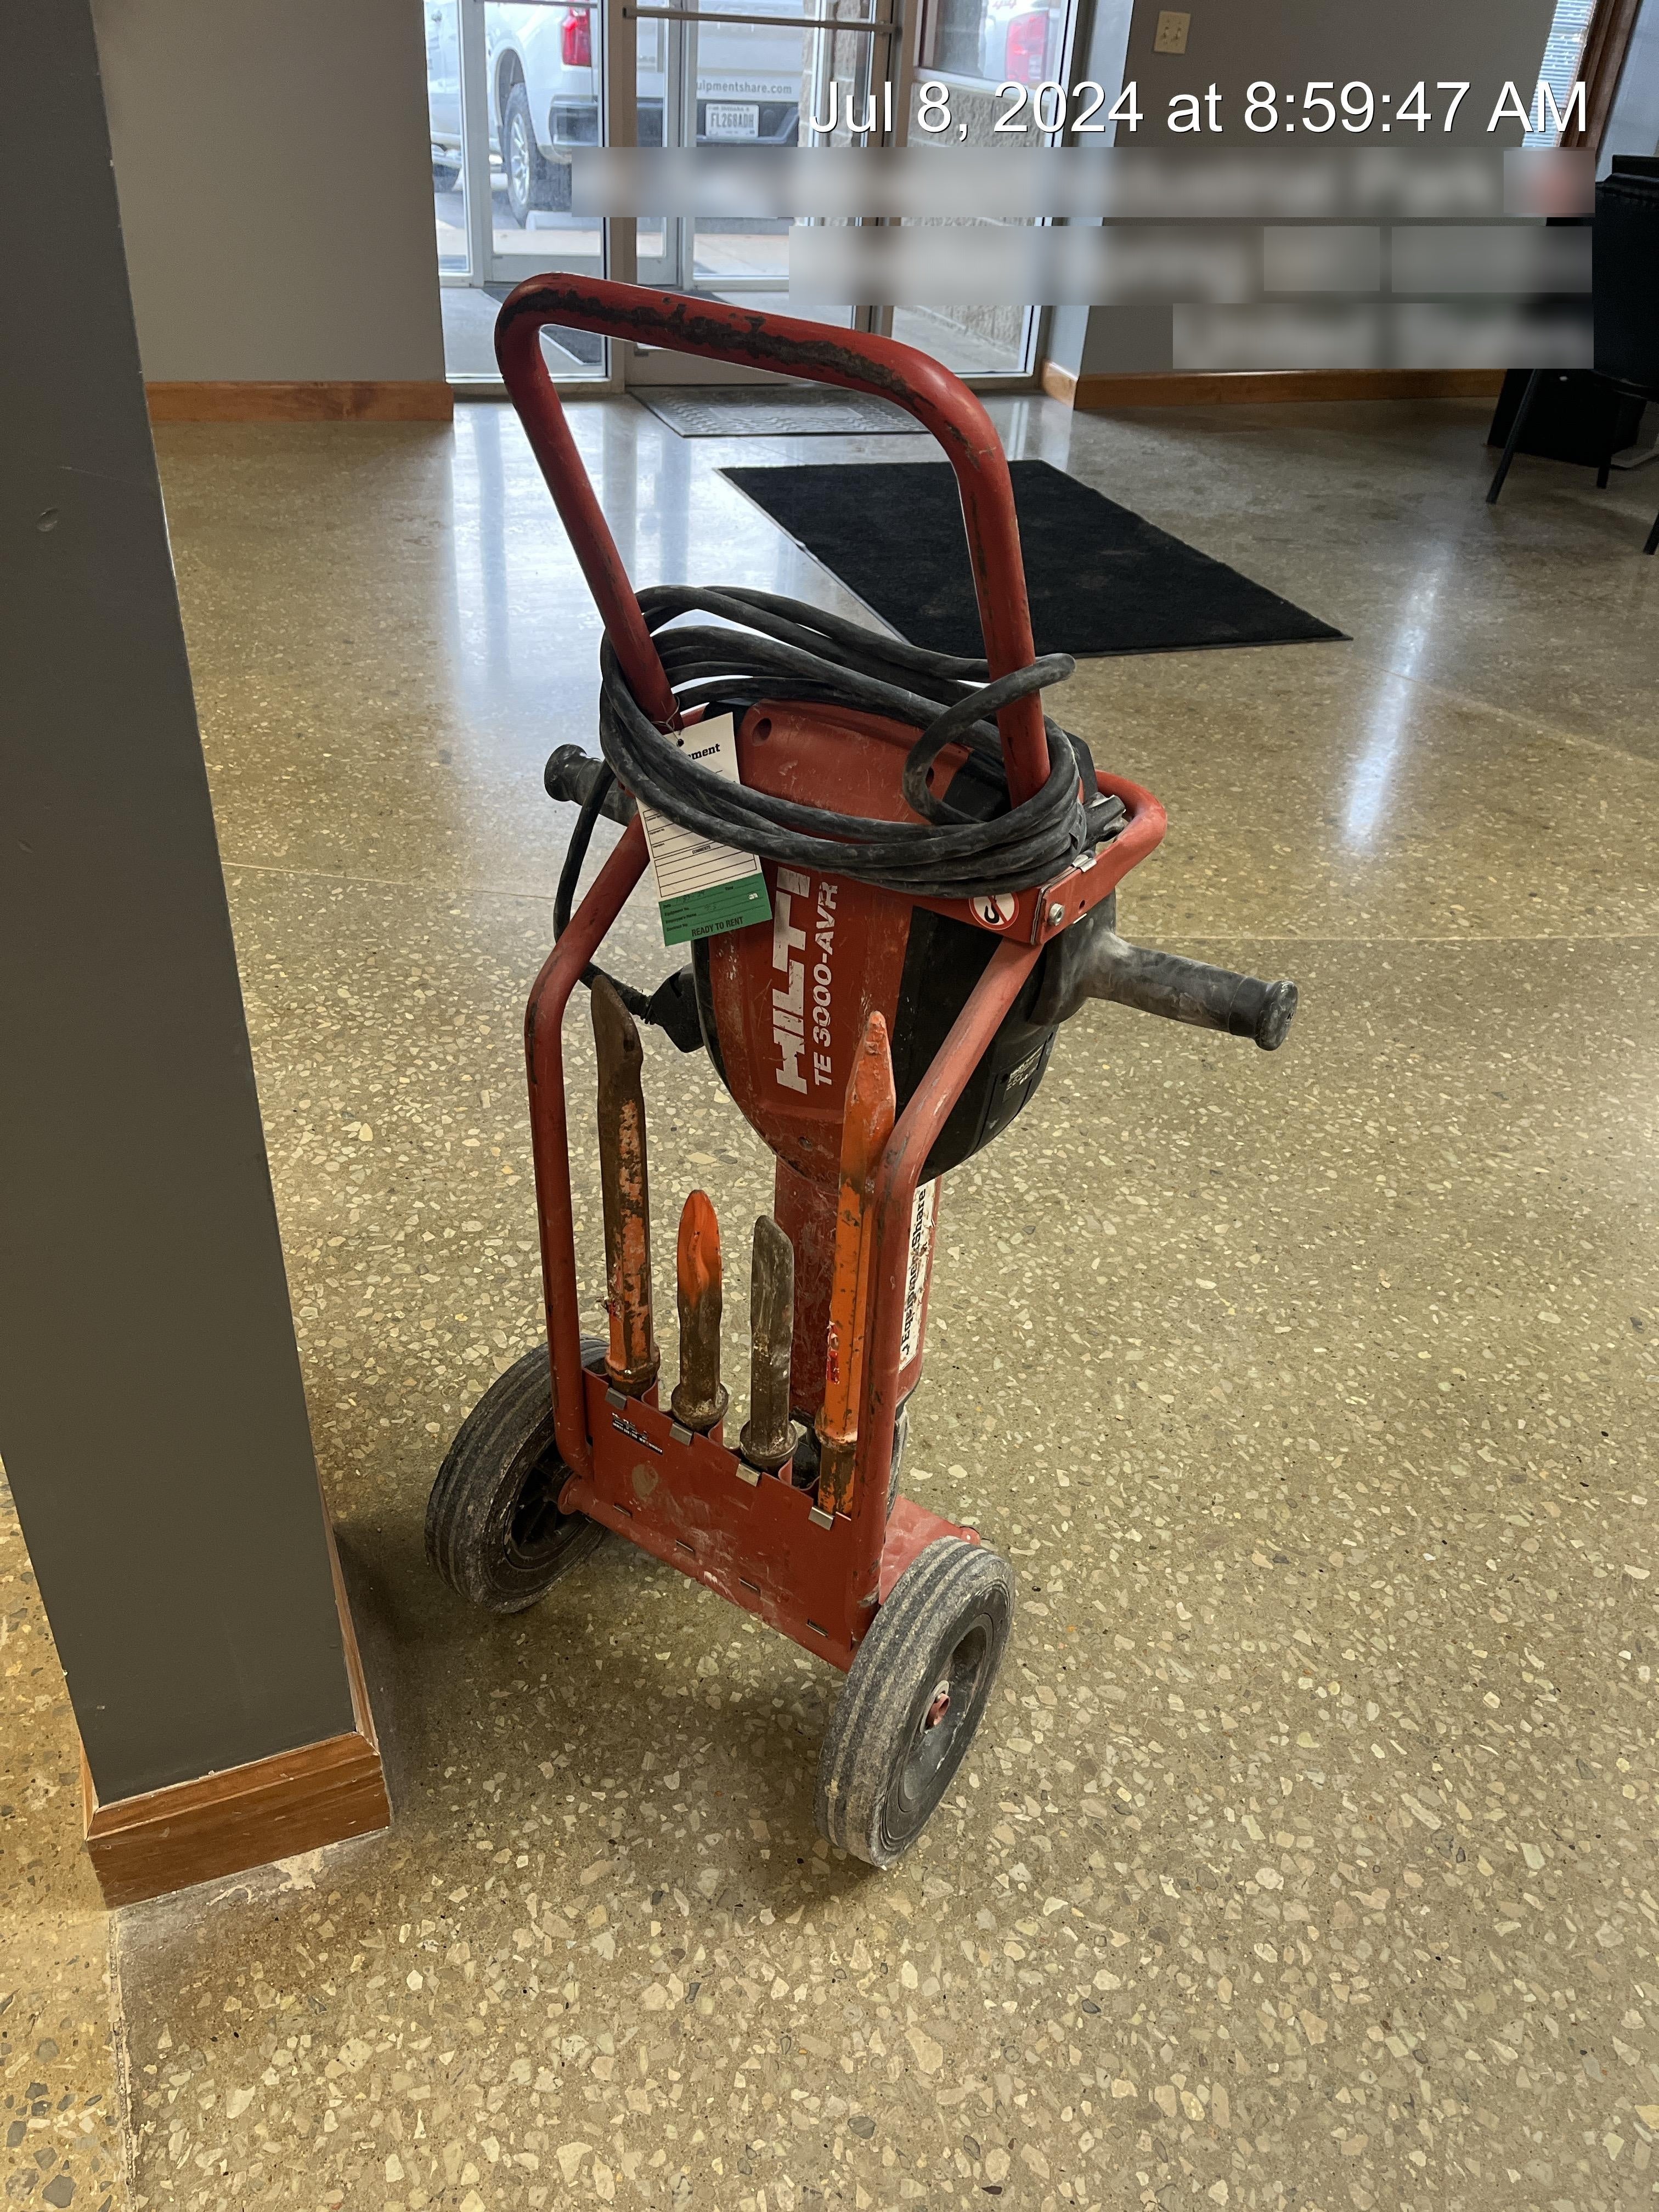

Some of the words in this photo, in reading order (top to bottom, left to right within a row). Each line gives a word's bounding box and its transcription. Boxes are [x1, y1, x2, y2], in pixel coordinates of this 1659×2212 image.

[691, 924, 714, 936] READY
[714, 921, 724, 930] TO
[725, 916, 744, 928] RENT
[812, 881, 839, 1049] 3000-AVR
[772, 866, 811, 1096] HILTI
[813, 1049, 833, 1086] TE
